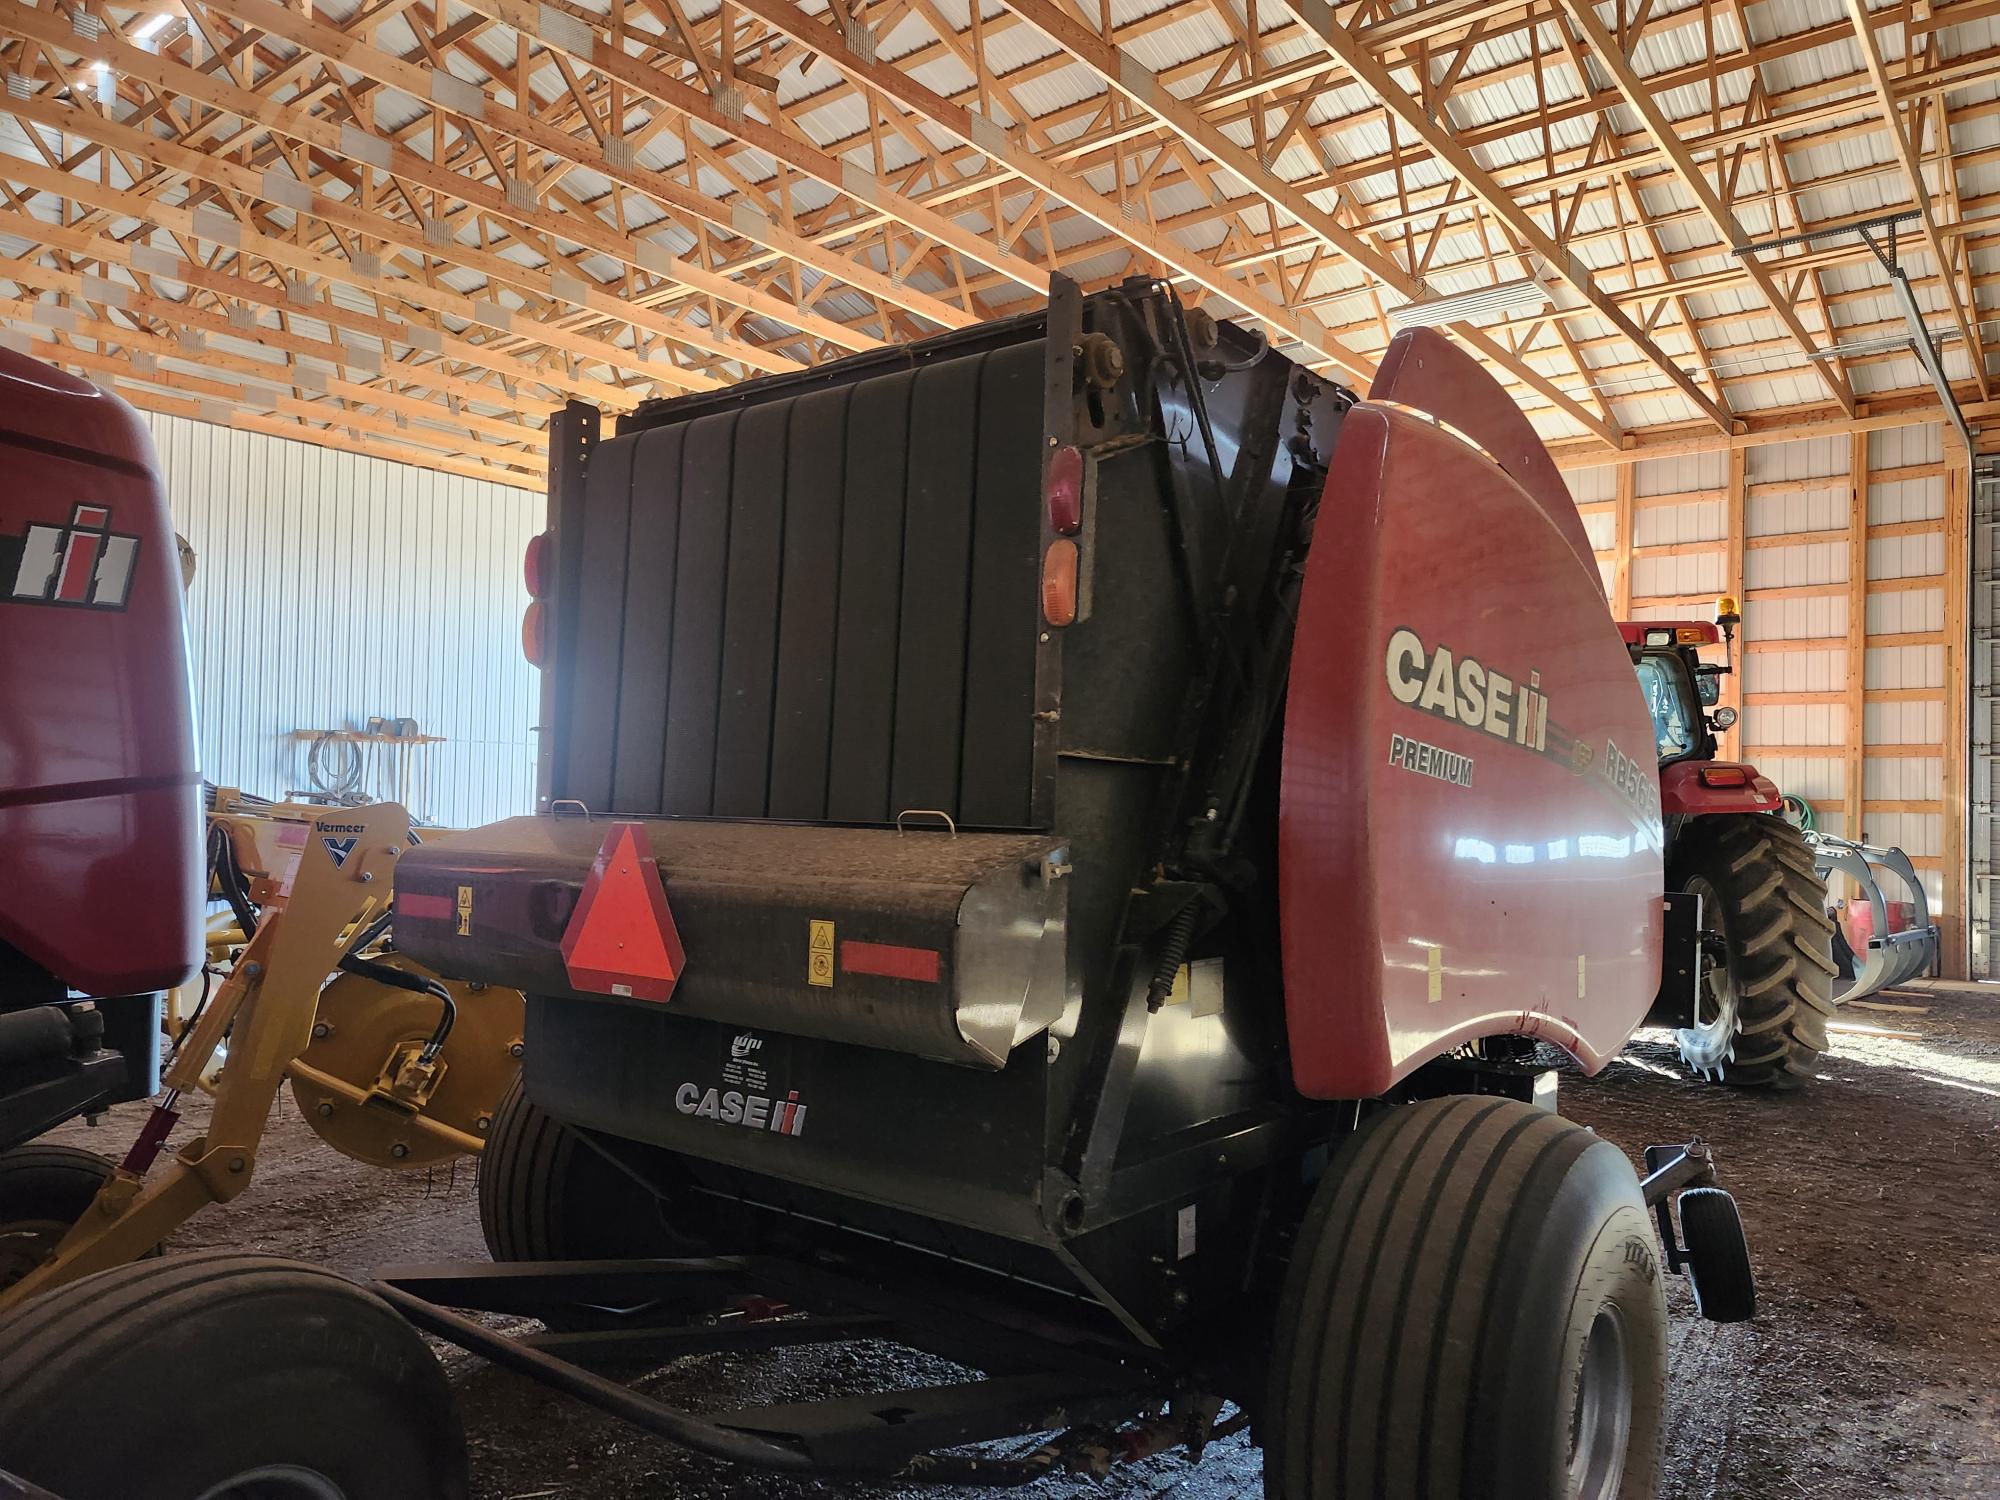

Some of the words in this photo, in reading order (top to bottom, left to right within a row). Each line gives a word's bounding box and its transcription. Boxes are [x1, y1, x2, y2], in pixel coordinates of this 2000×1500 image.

[1385, 629, 1513, 738] CASE
[1389, 733, 1475, 788] PREMIUM
[316, 821, 366, 833] Vermeer
[675, 1082, 770, 1129] CASE
